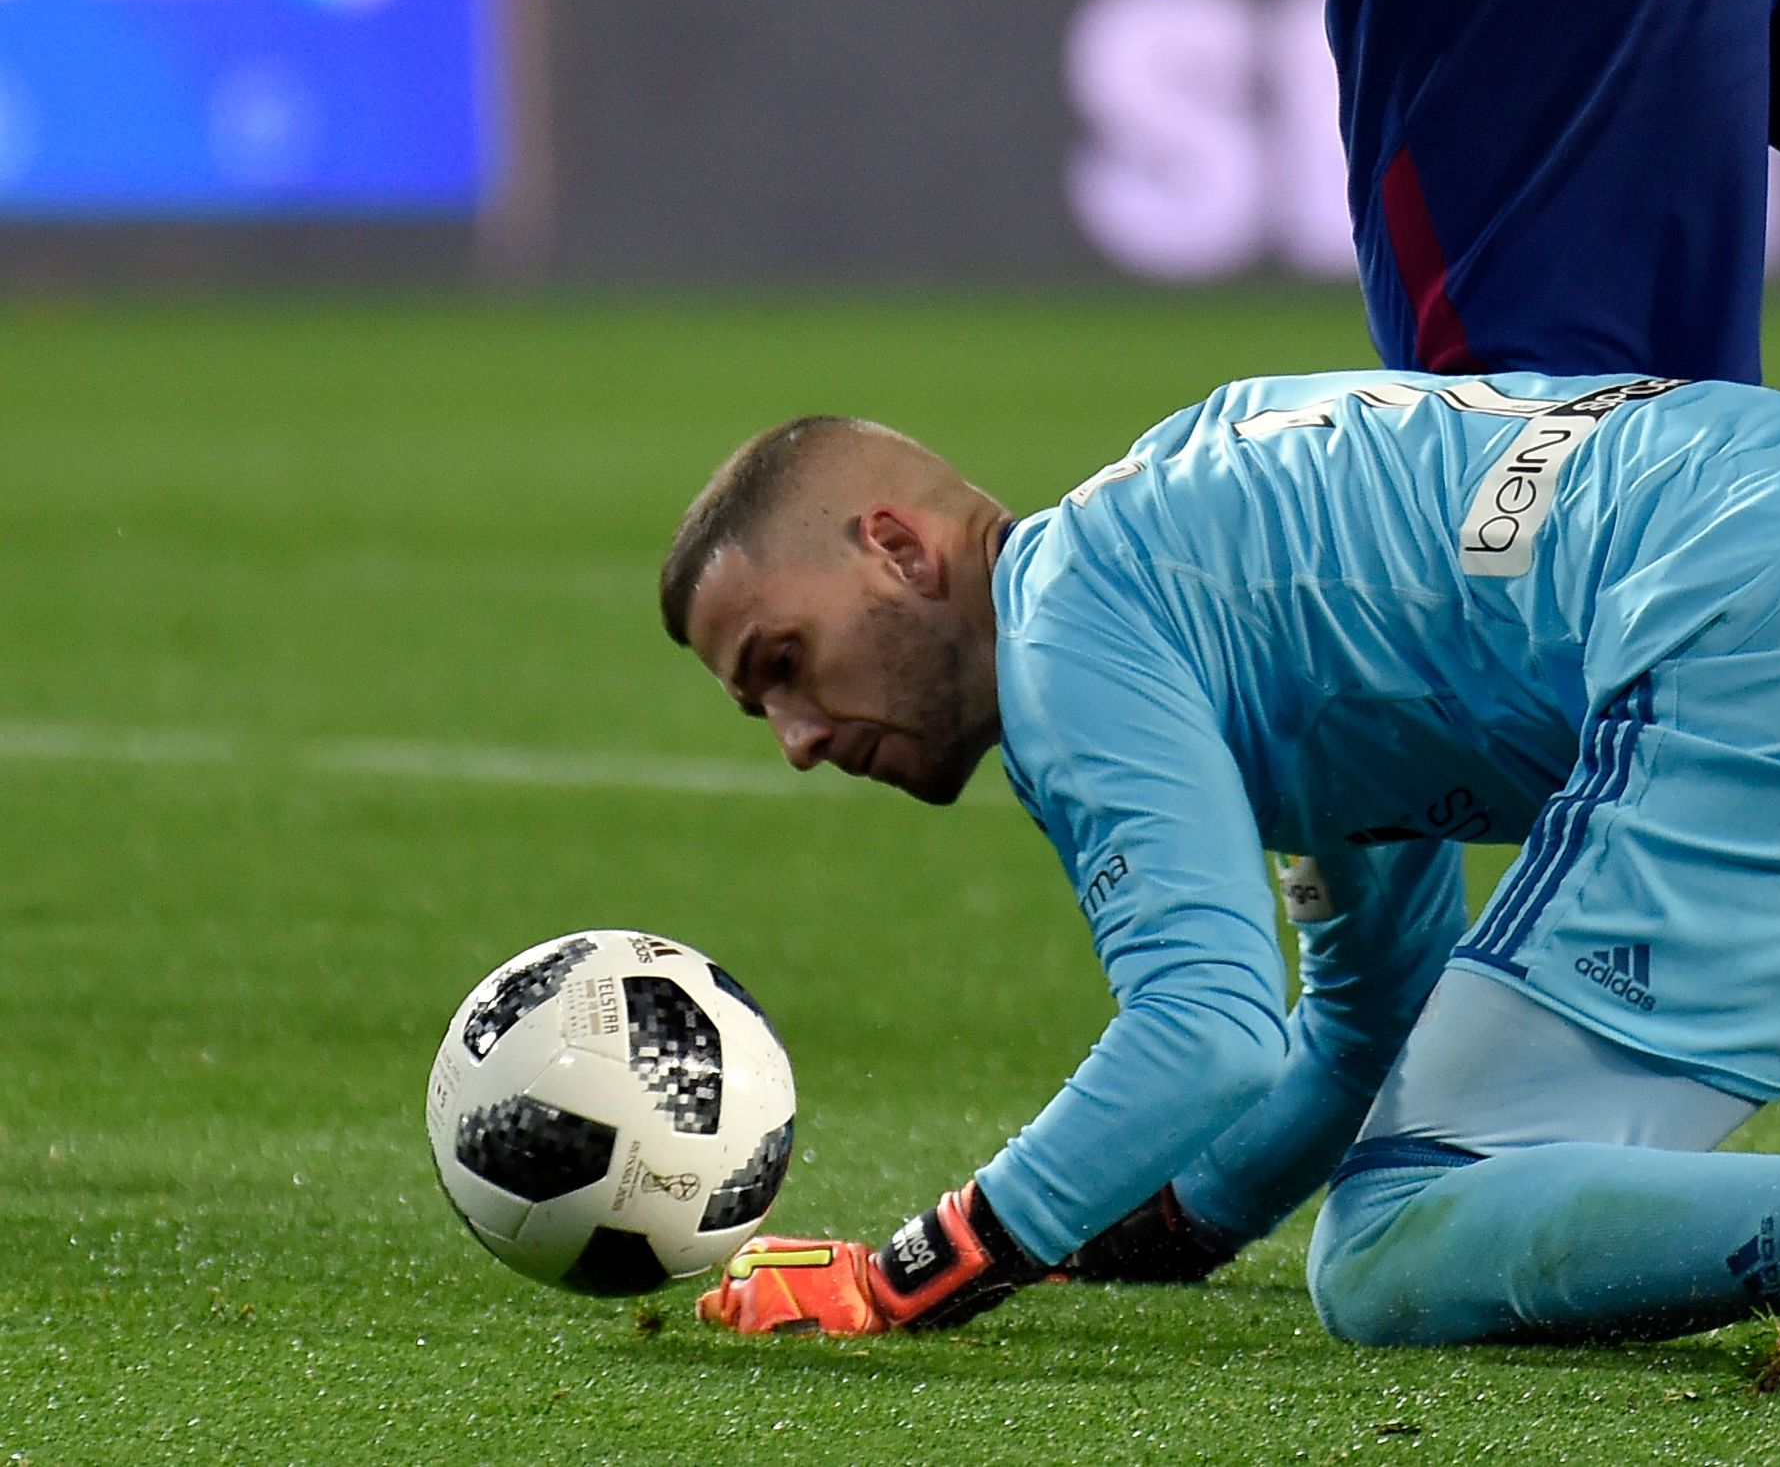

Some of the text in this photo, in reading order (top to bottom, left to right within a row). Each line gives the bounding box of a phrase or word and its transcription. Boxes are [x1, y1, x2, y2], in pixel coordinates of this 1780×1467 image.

[1464, 429, 1572, 552] beIN
[598, 976, 620, 1035] TELSTAR
[1574, 957, 1656, 1012] adidas
